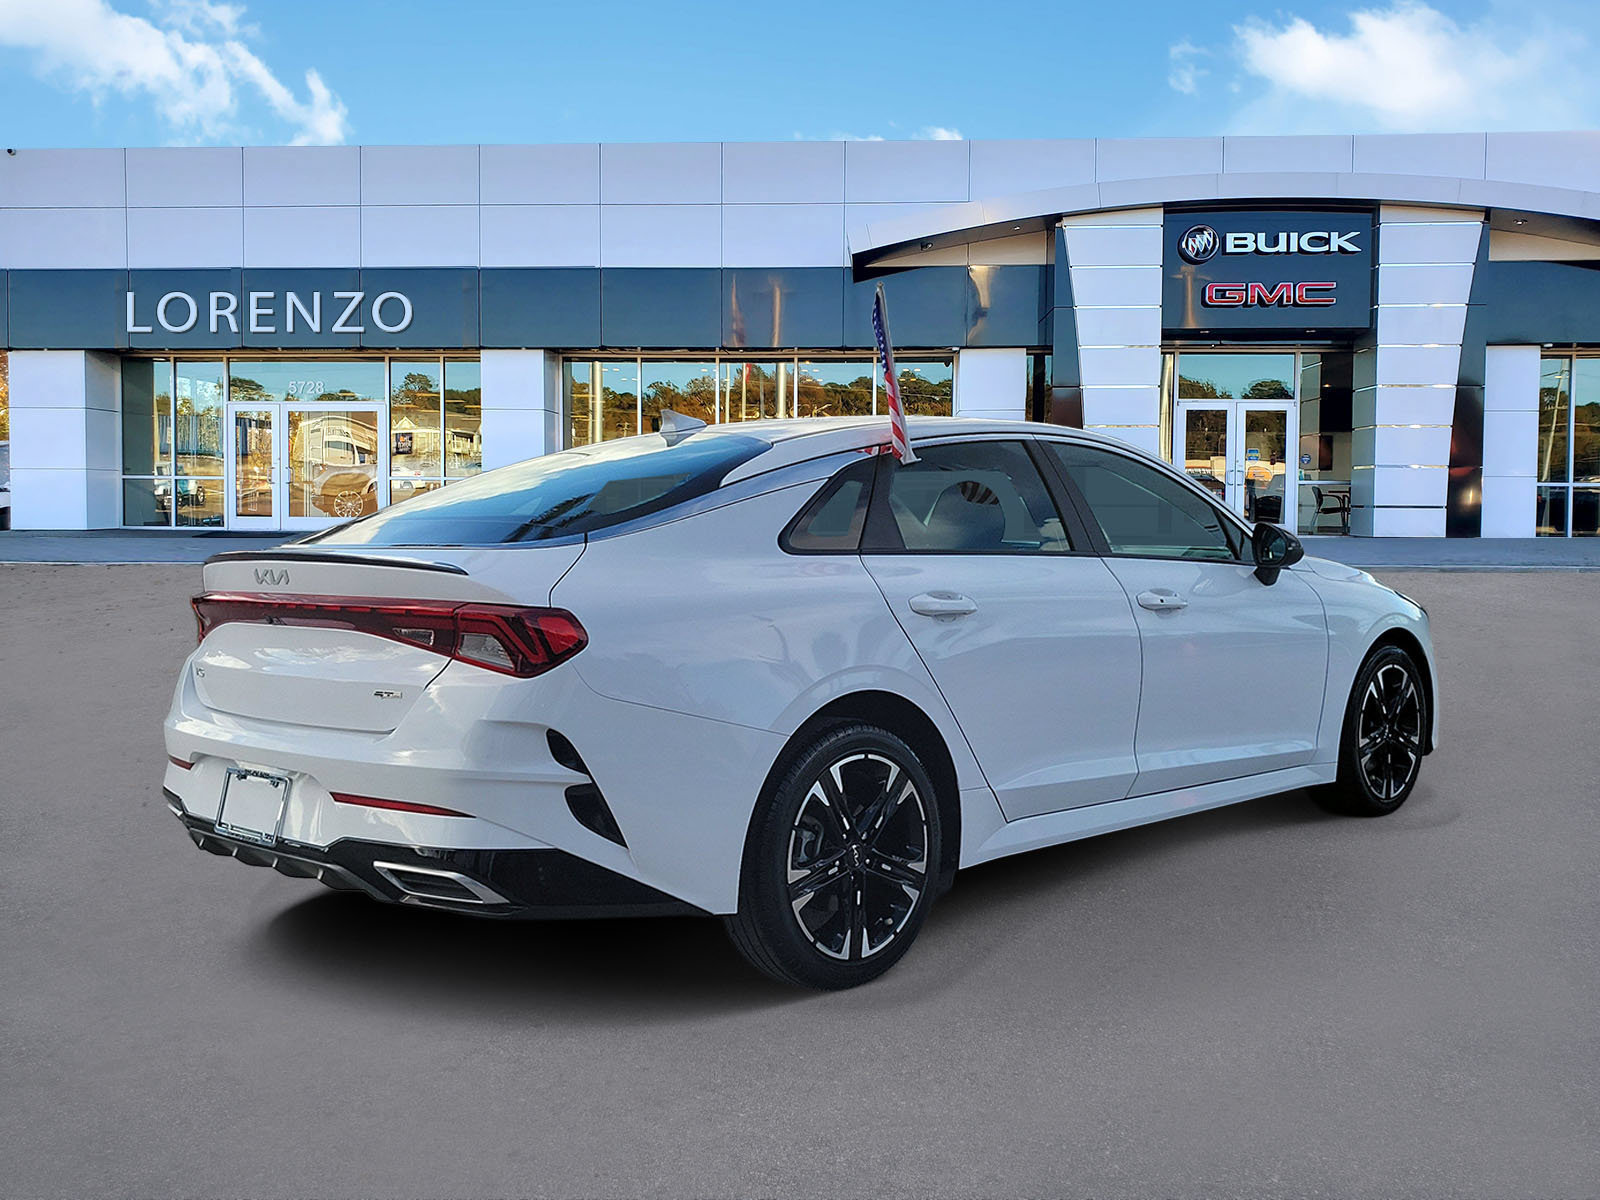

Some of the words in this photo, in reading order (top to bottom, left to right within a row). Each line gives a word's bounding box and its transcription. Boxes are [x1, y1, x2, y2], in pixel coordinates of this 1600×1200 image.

[1226, 231, 1362, 253] BUICK
[1206, 282, 1337, 305] GMC
[126, 291, 413, 333] LORENZO
[288, 380, 324, 394] 5728
